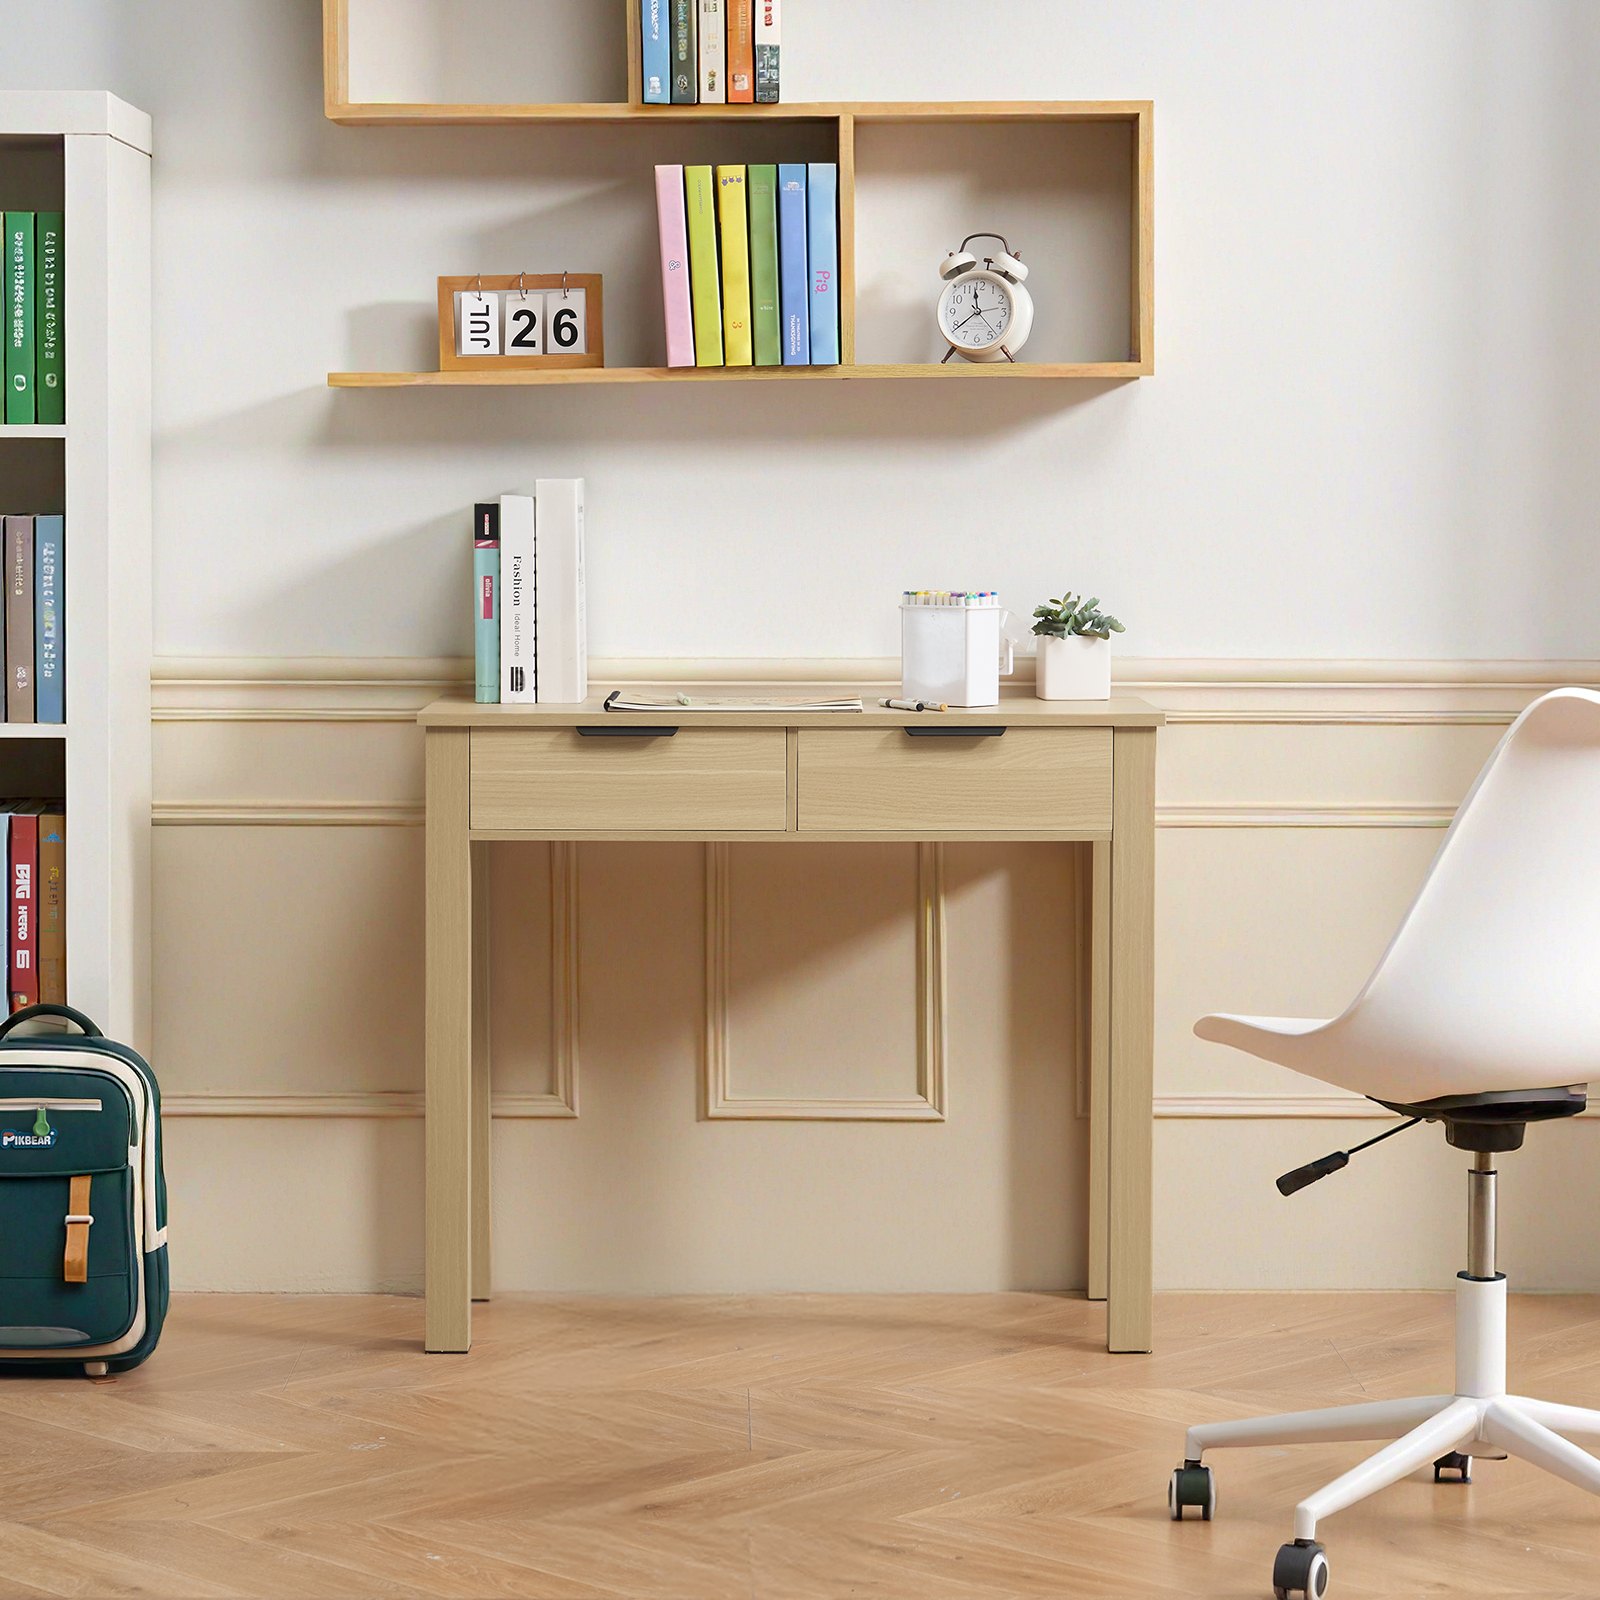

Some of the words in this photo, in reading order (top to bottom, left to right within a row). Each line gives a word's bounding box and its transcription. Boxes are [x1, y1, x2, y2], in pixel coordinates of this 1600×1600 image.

[814, 270, 831, 294] Pig
[975, 281, 986, 290] 12
[963, 285, 971, 294] 11
[991, 285, 995, 294] 1
[952, 295, 962, 304] 10
[998, 295, 1004, 304] 2
[950, 308, 956, 316] 9
[1001, 308, 1007, 317] 3
[470, 304, 491, 348] JUL
[511, 309, 537, 347] 2
[553, 308, 578, 347] 6
[732, 320, 743, 329] 3
[953, 320, 959, 329] 8
[996, 320, 1002, 330] 4
[963, 331, 968, 340] 7
[974, 333, 980, 343] 6
[987, 331, 994, 340] 5
[513, 556, 523, 606] Fashion
[15, 864, 31, 899] BIG
[17, 905, 28, 941] HERO
[2, 1131, 52, 1146] PIKBEAR
